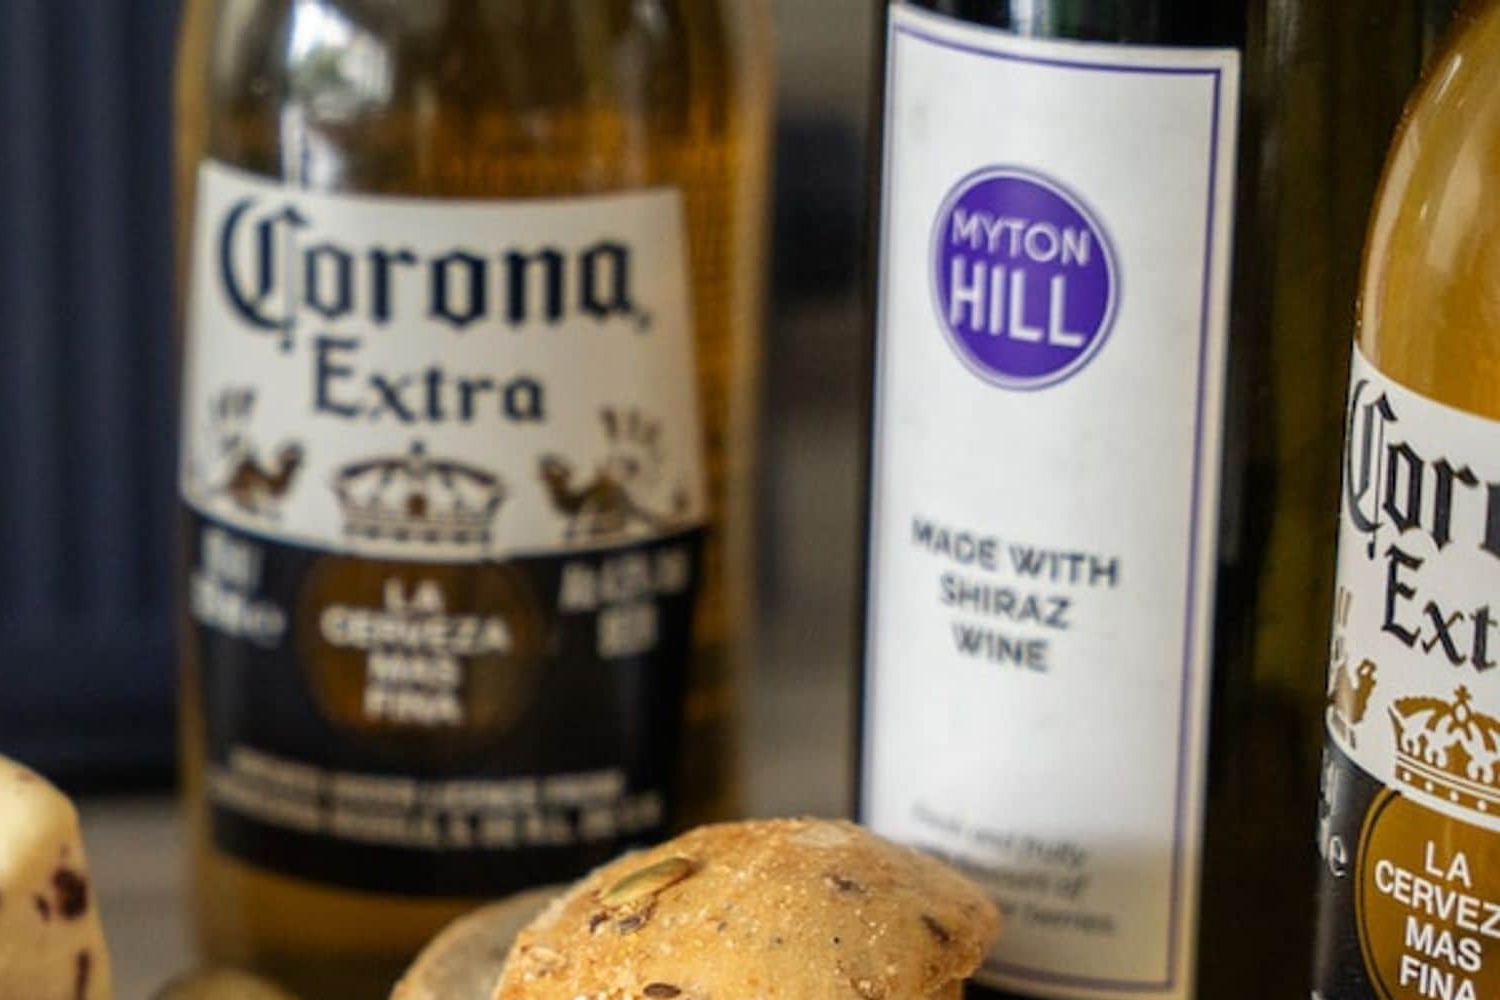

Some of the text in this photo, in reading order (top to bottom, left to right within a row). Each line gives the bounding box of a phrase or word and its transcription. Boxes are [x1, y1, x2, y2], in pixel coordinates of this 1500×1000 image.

[219, 198, 634, 353] Corona
[951, 207, 1092, 268] MYTON
[950, 253, 1086, 348] HILL
[312, 335, 547, 423] Extra
[1347, 379, 1500, 561] Cor
[911, 513, 1120, 589] MADE WITH
[383, 576, 445, 613] LA
[938, 571, 1073, 631] SHIRAZ
[1381, 543, 1497, 672] Ext
[952, 623, 1051, 676] WINE
[1374, 858, 1500, 940] CERVEZ
[1424, 839, 1473, 889] LA
[1404, 914, 1483, 973] MAS
